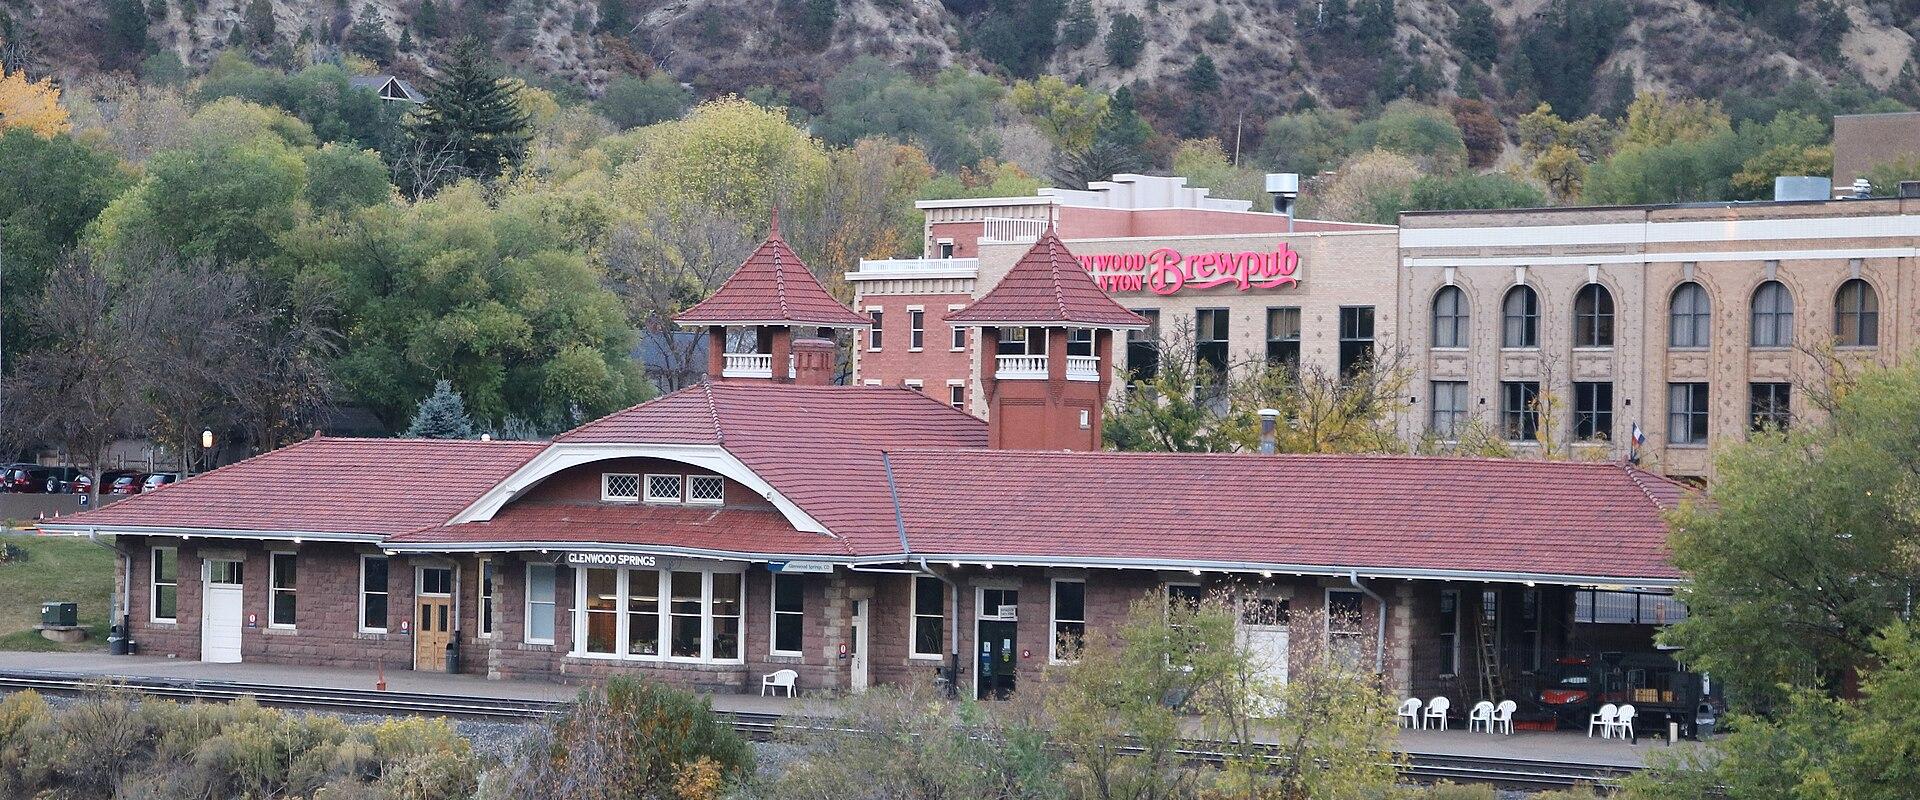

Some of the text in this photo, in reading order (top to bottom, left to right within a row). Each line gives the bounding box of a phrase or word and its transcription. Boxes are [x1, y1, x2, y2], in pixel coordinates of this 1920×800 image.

[1076, 254, 1146, 272] NWOOD
[1147, 242, 1299, 296] Brewpub
[1091, 274, 1144, 293] NYON
[80, 495, 87, 505] P
[568, 553, 656, 567] GLENWOOD SPRINGS
